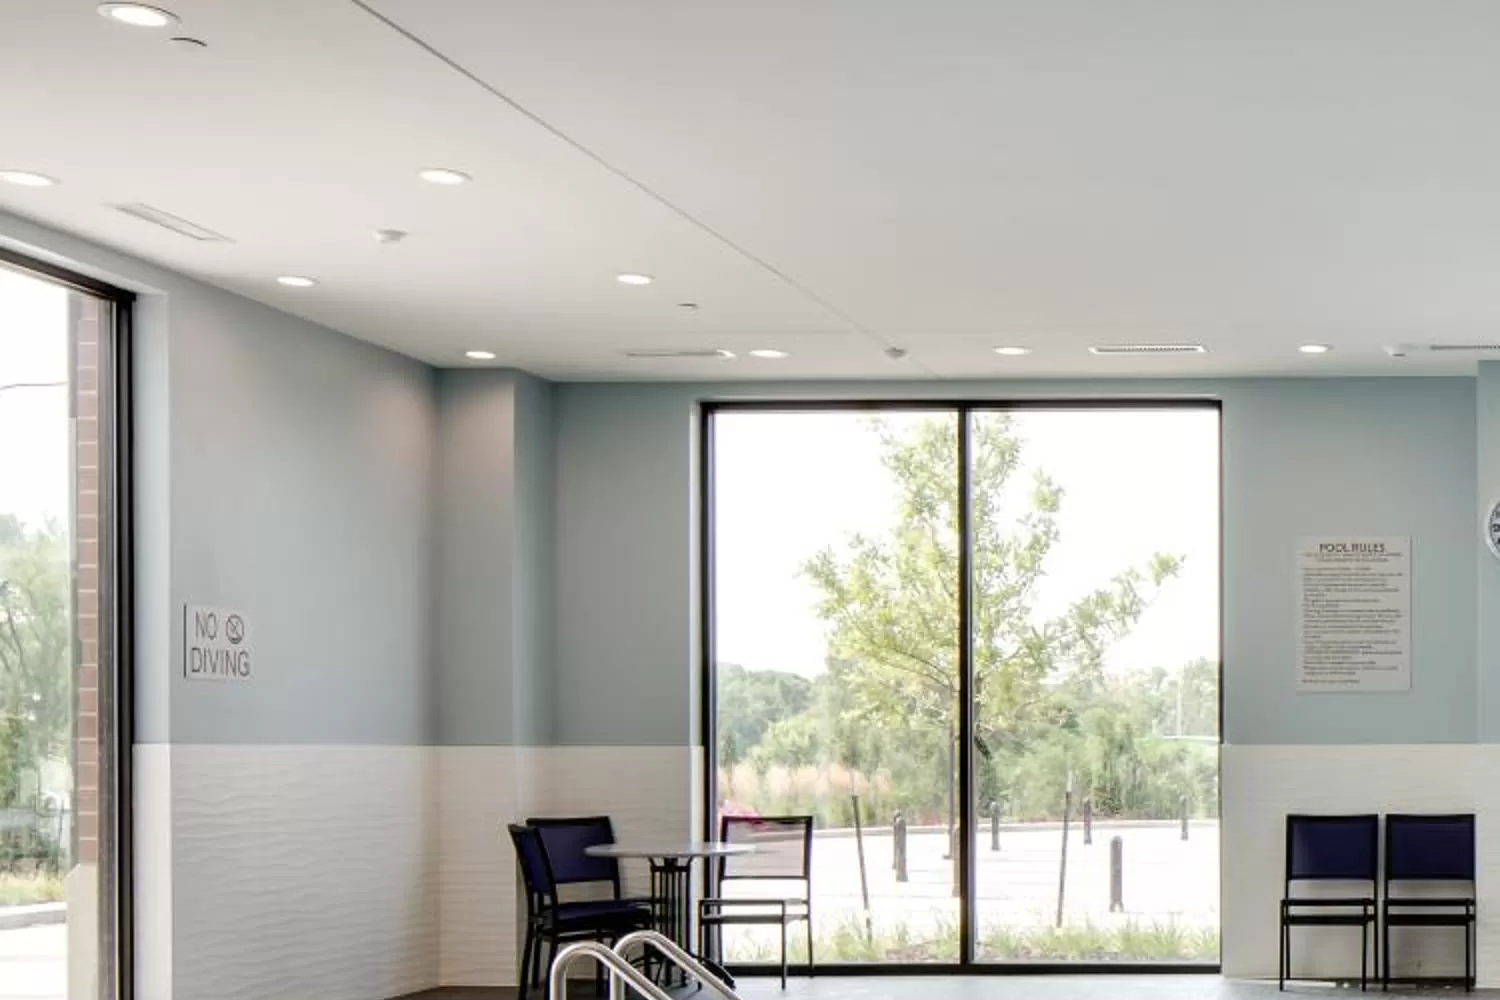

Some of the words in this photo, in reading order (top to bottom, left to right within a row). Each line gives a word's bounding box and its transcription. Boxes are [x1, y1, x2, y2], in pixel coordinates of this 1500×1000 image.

[1319, 543, 1350, 553] POOL
[1351, 543, 1385, 553] RULES
[195, 611, 217, 640] NO
[191, 647, 250, 677] DIVING
